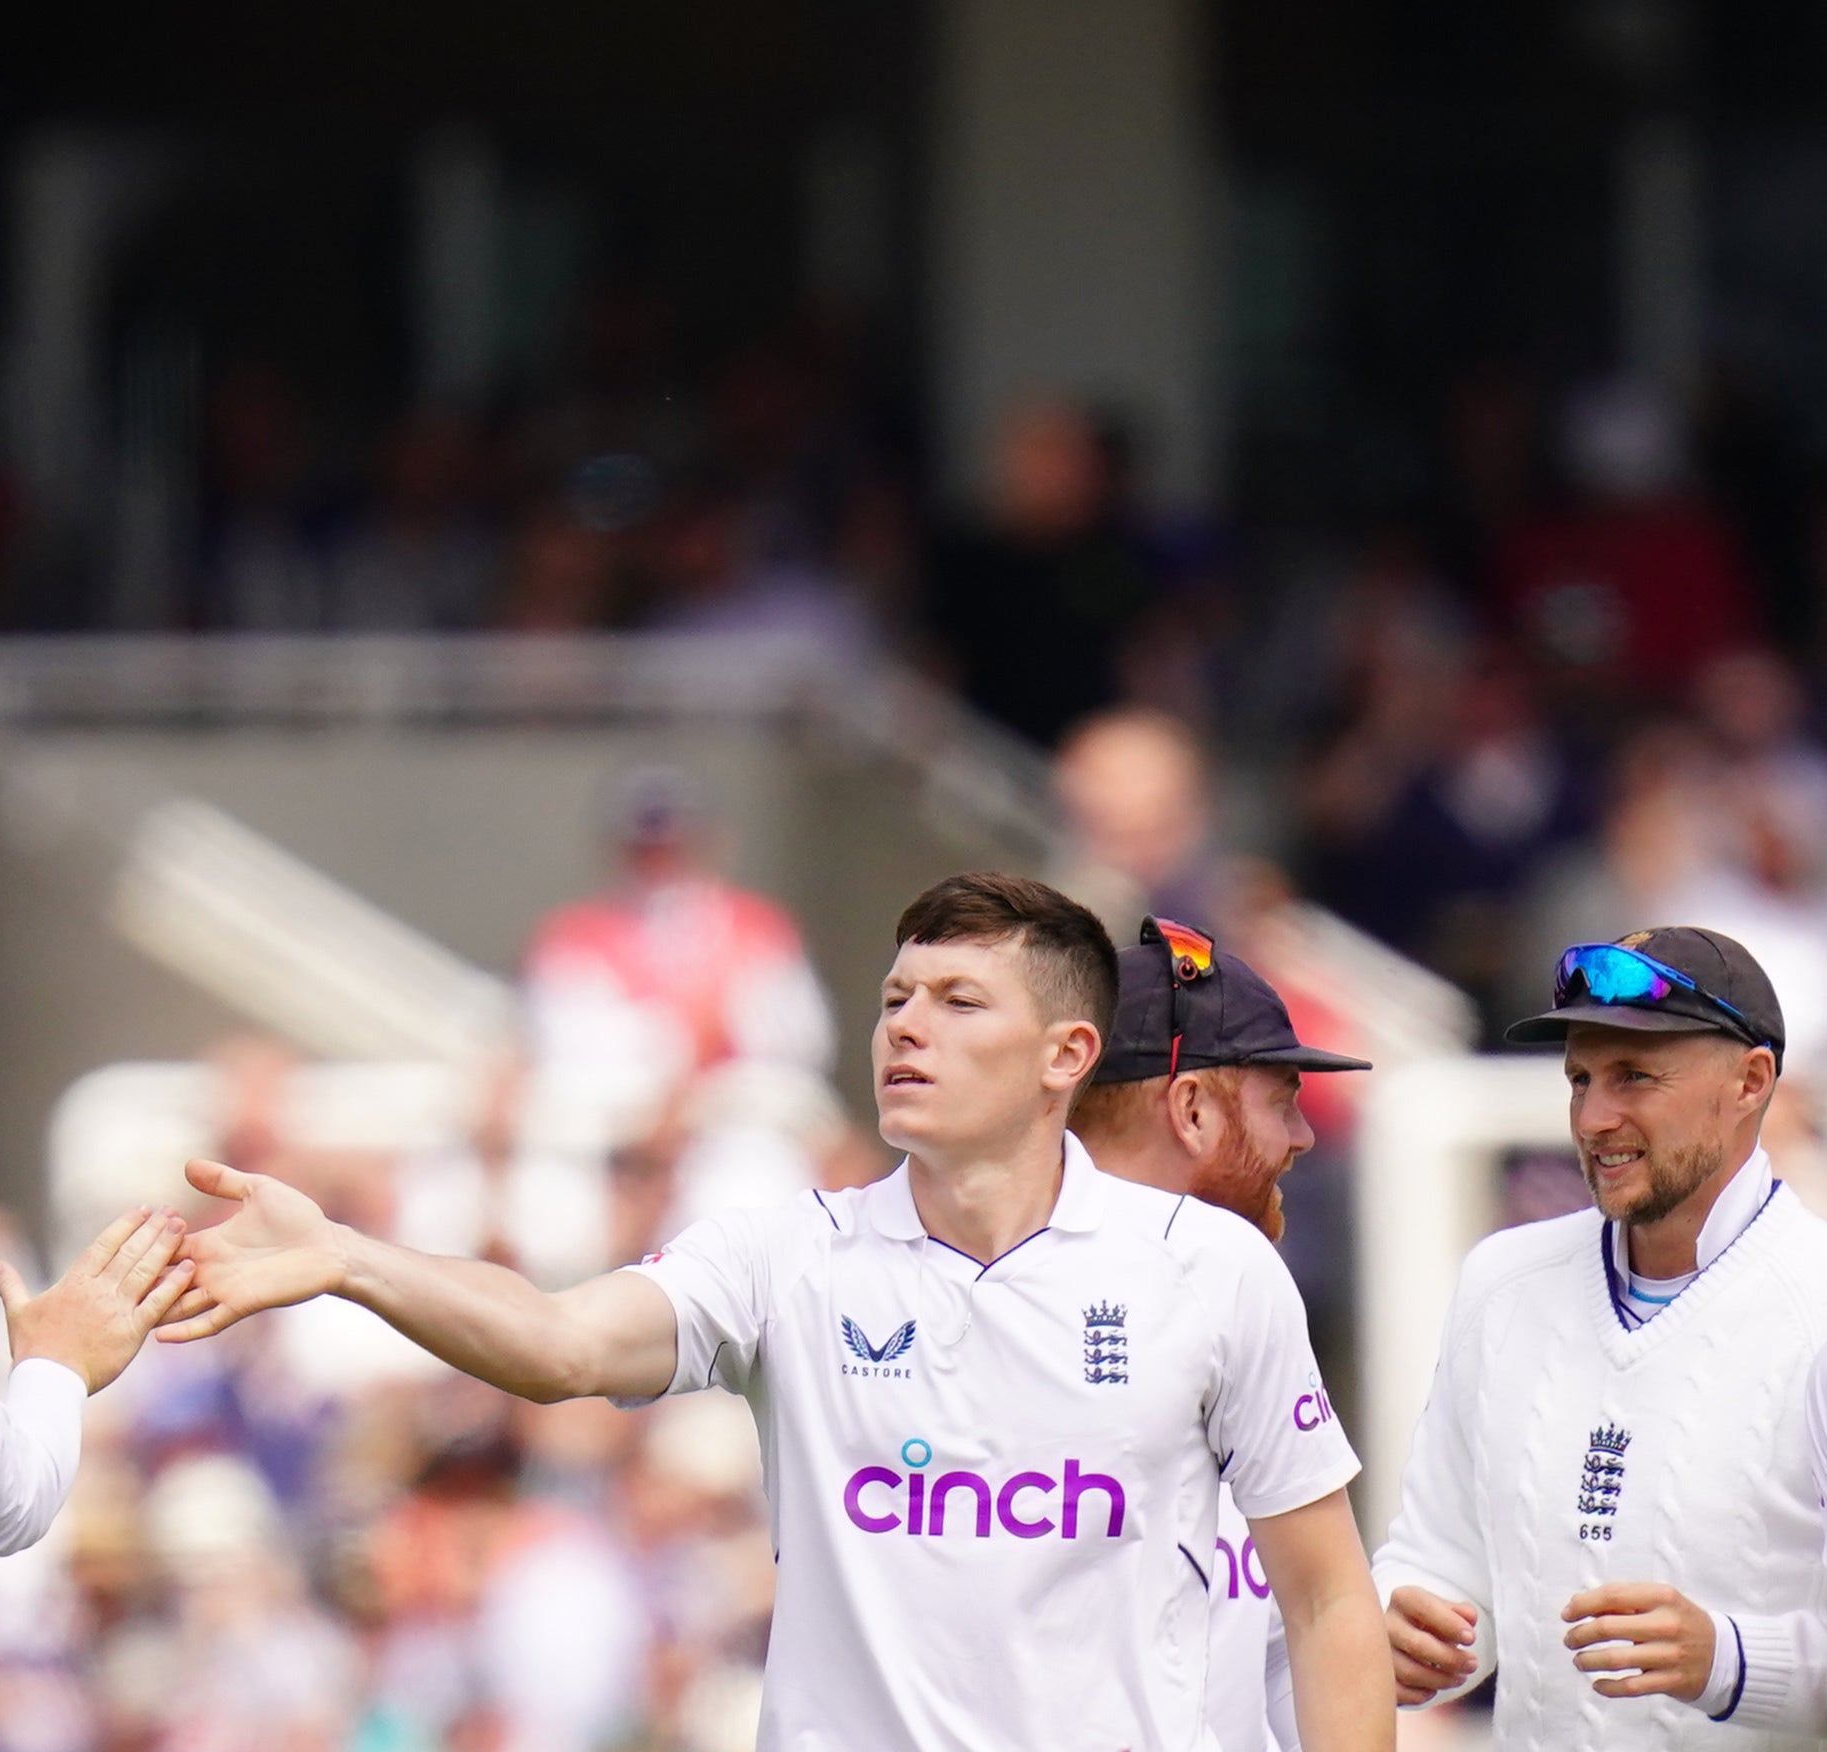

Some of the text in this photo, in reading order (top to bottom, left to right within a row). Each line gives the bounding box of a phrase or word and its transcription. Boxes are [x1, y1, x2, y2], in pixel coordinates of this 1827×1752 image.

[841, 1363, 912, 1380] CASTORE
[843, 1438, 1127, 1540] cinch
[1579, 1523, 1613, 1541] 655
